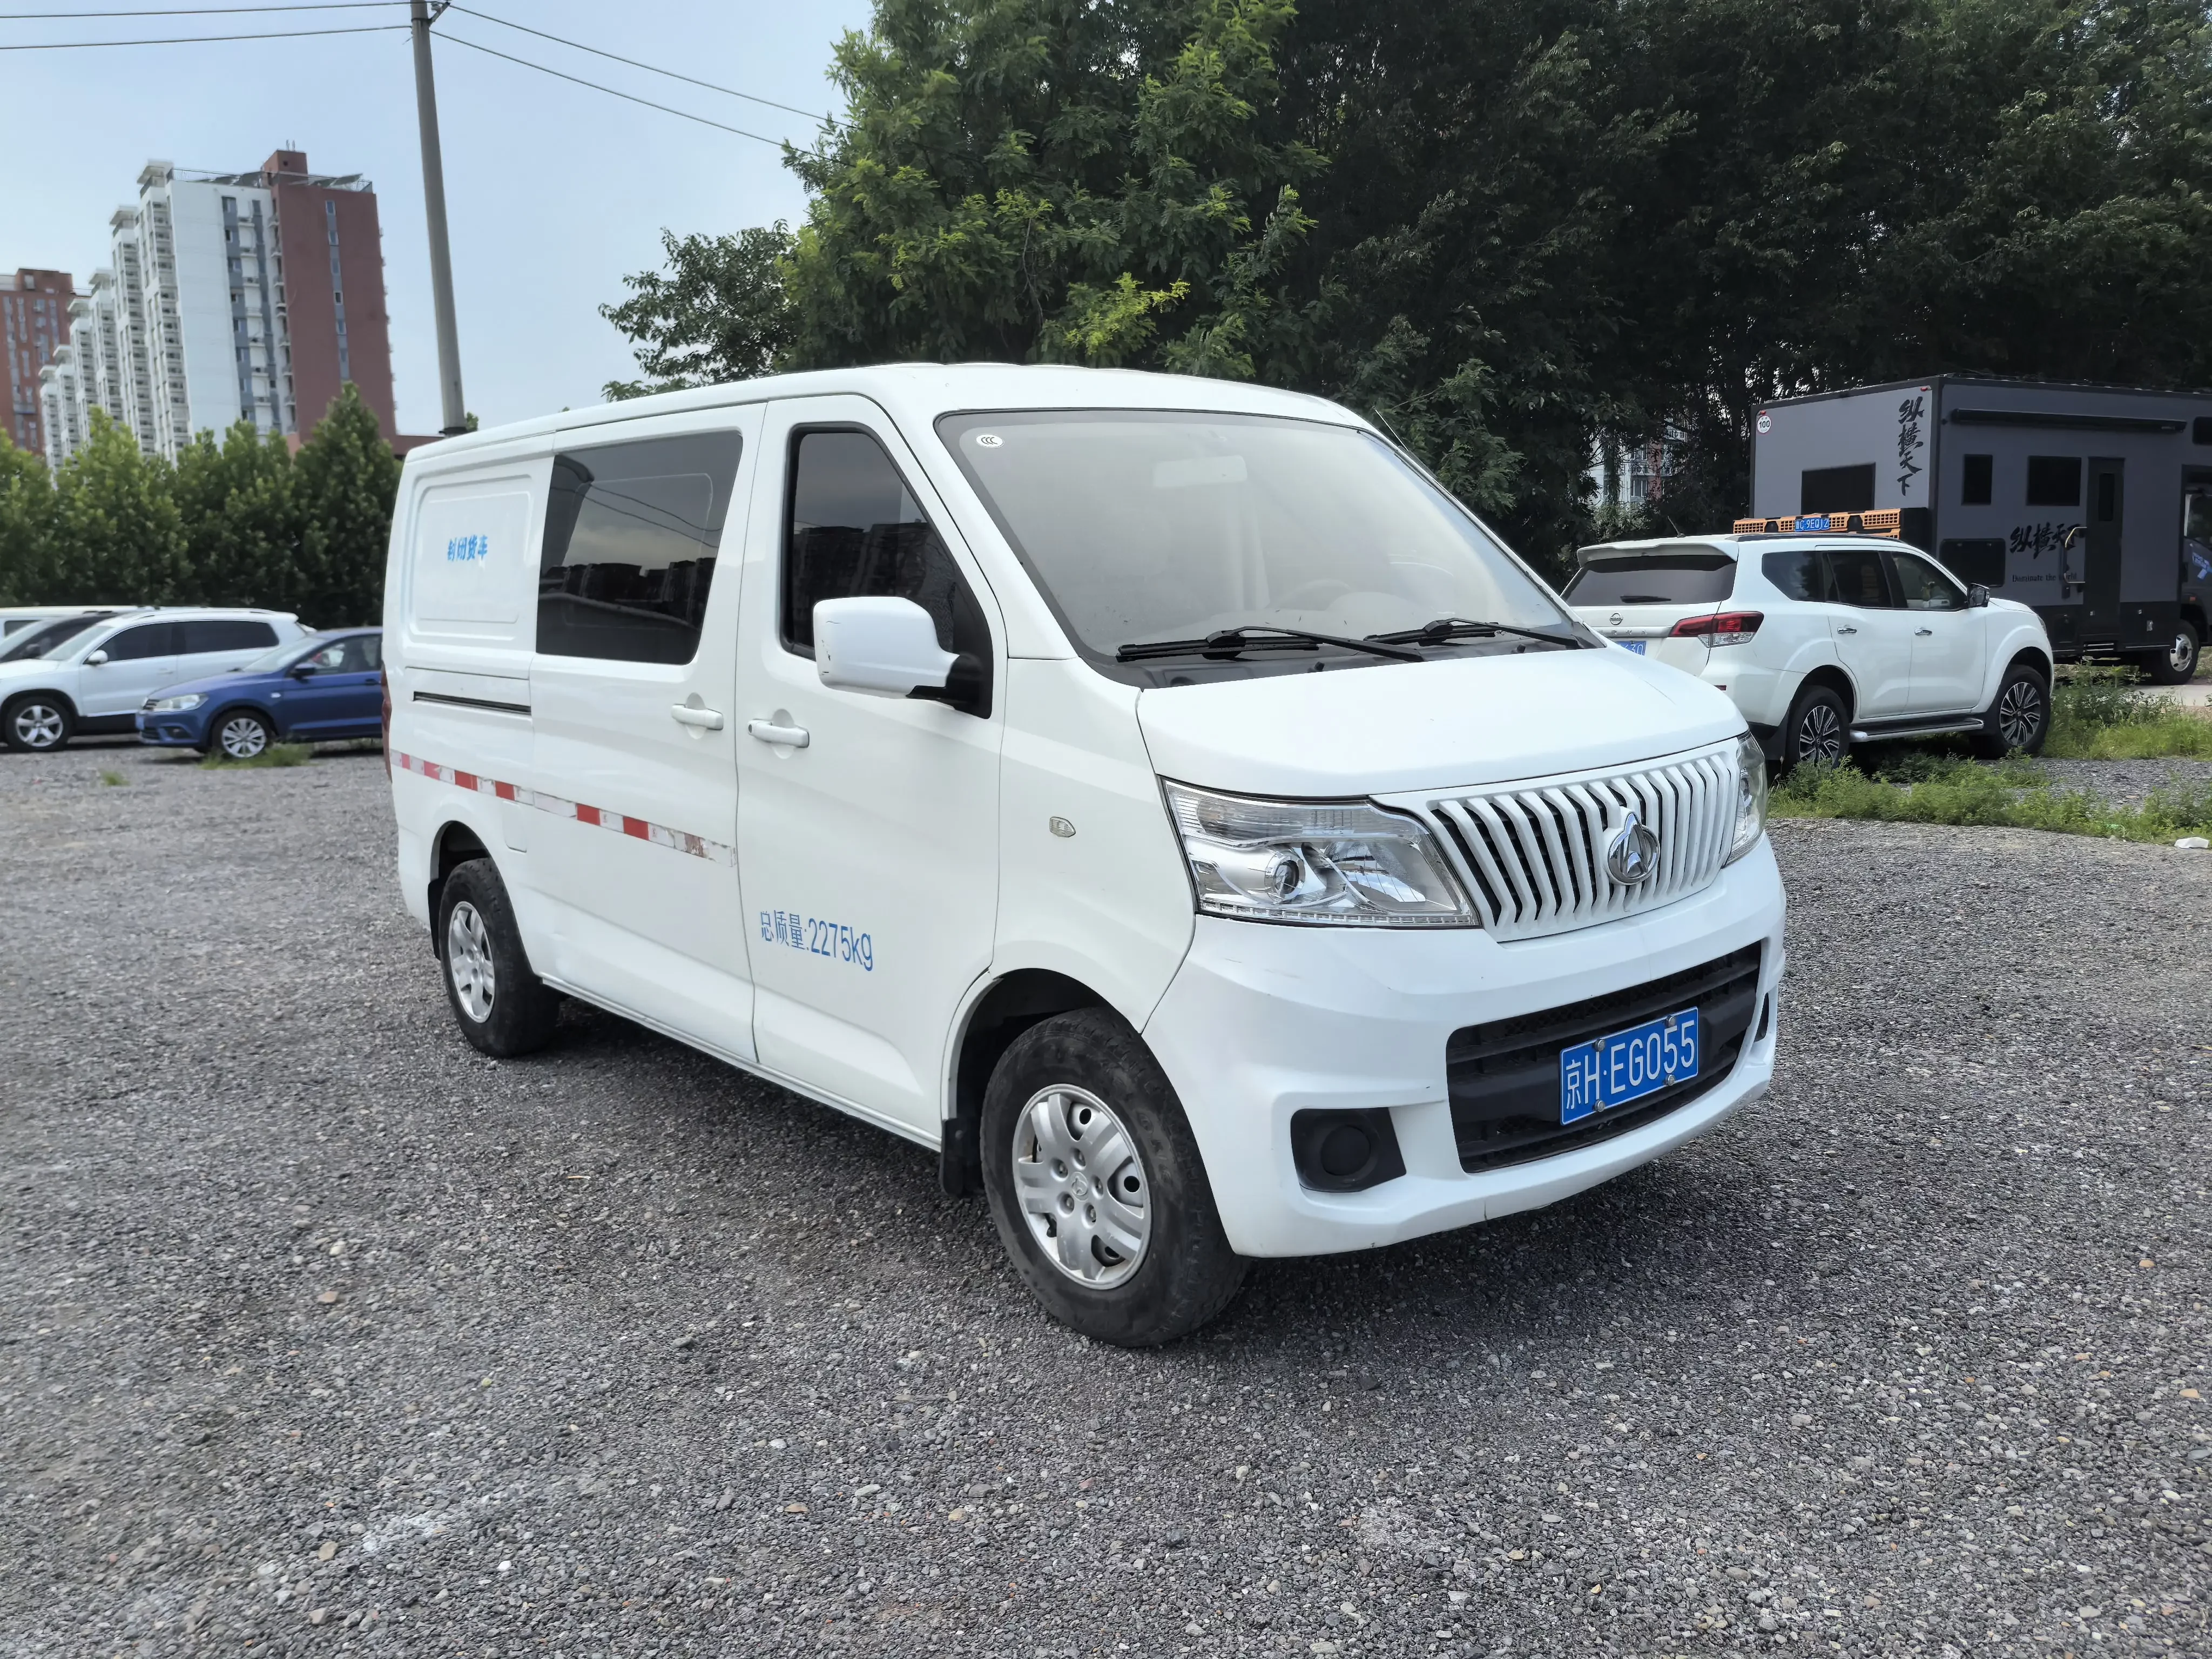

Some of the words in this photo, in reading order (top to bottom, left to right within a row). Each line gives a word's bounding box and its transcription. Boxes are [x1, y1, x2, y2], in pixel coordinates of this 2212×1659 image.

[1759, 420, 1770, 428] 100
[2046, 573, 2056, 581] the
[760, 910, 873, 971] 总质量:2275kg
[1566, 1020, 1695, 1109] 京H·EG055
